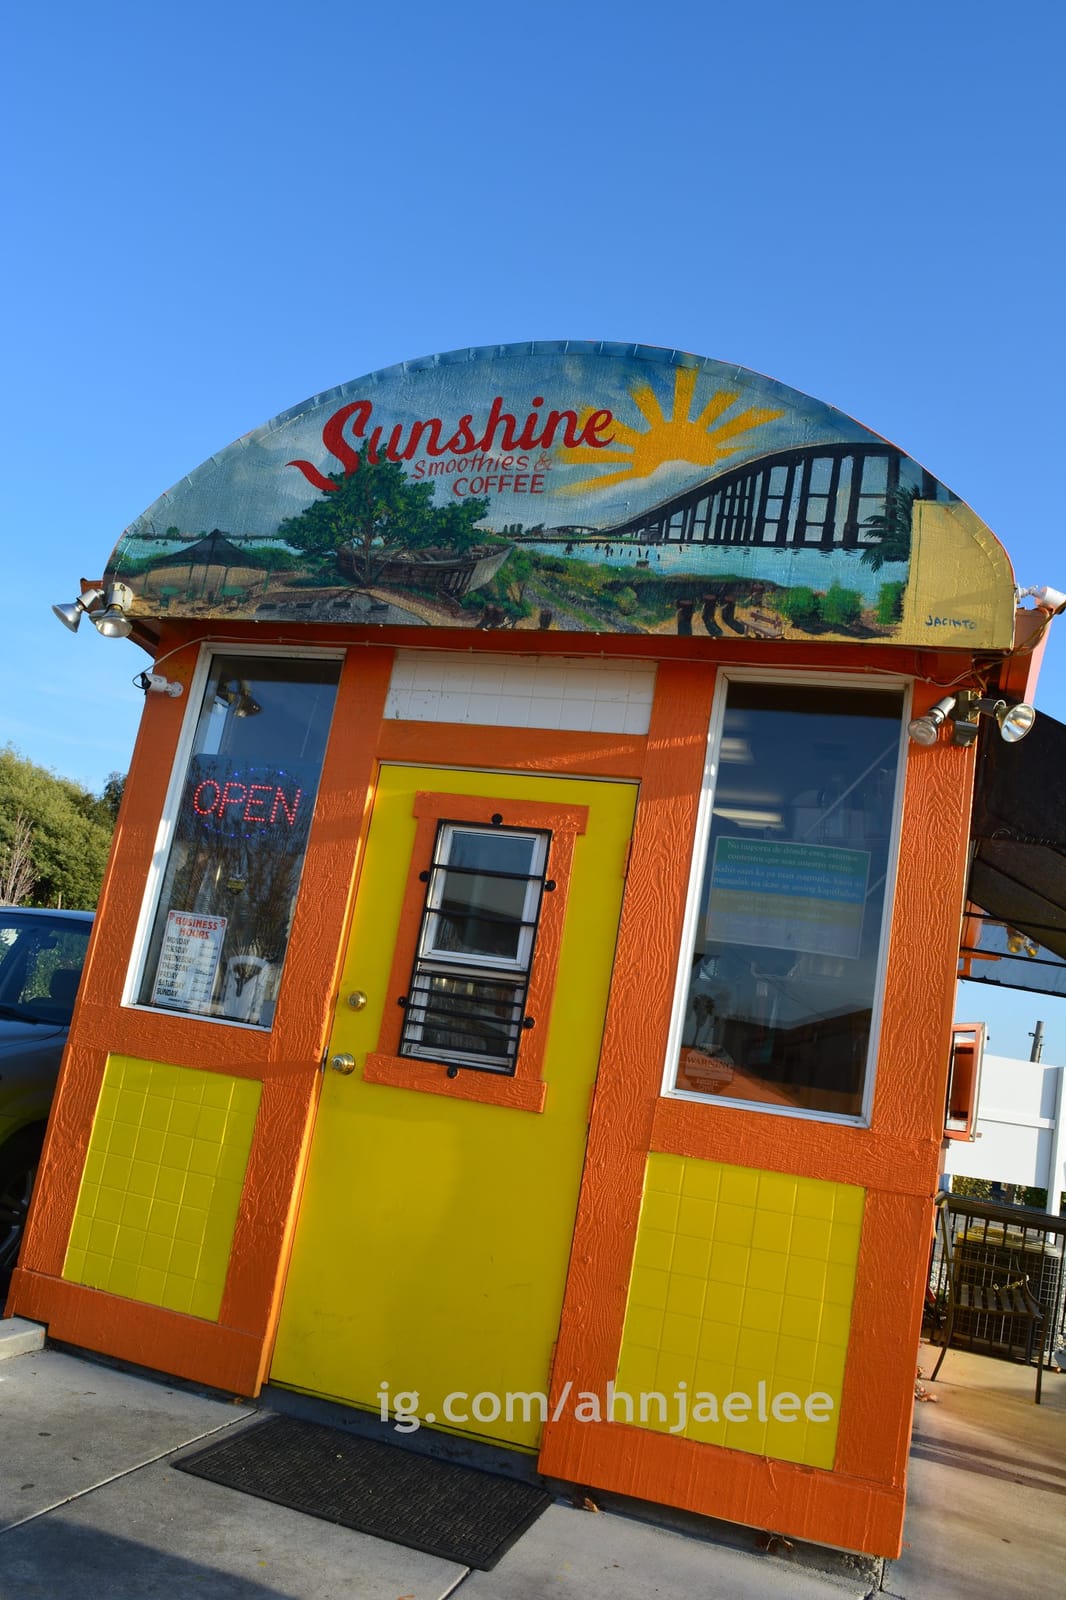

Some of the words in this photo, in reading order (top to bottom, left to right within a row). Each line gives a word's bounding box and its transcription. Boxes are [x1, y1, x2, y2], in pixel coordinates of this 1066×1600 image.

[285, 396, 616, 491] Sunshine
[411, 454, 530, 480] Smoothies
[452, 473, 545, 496] COFFEE
[193, 779, 302, 826] OPEN
[176, 917, 218, 930] BUSINESS
[167, 936, 190, 945] MONDAY
[180, 928, 210, 939] HOURS
[156, 987, 179, 998] SUNDAY
